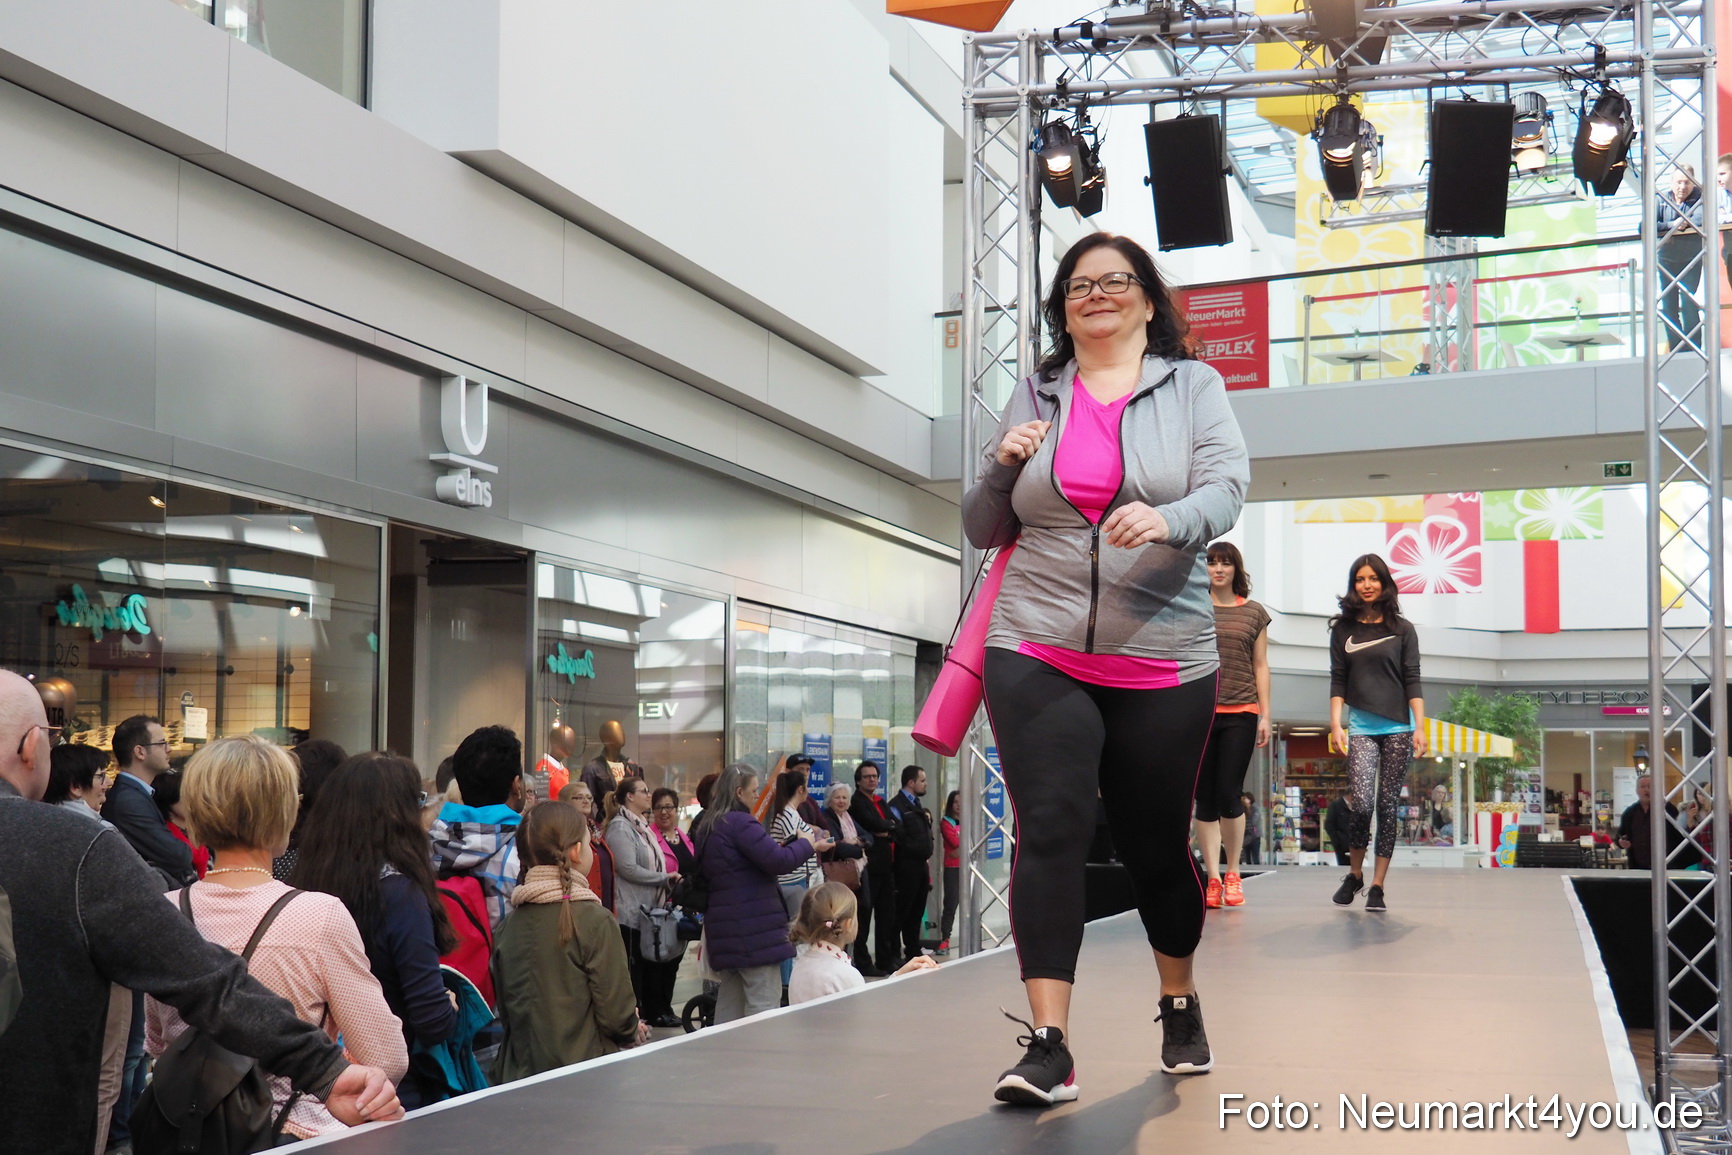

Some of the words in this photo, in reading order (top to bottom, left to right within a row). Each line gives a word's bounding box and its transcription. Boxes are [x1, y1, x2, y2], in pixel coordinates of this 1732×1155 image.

[1186, 307, 1246, 322] NeuerMarkt
[1226, 372, 1258, 384] aktuell
[446, 375, 488, 456] U
[447, 467, 492, 508] eins
